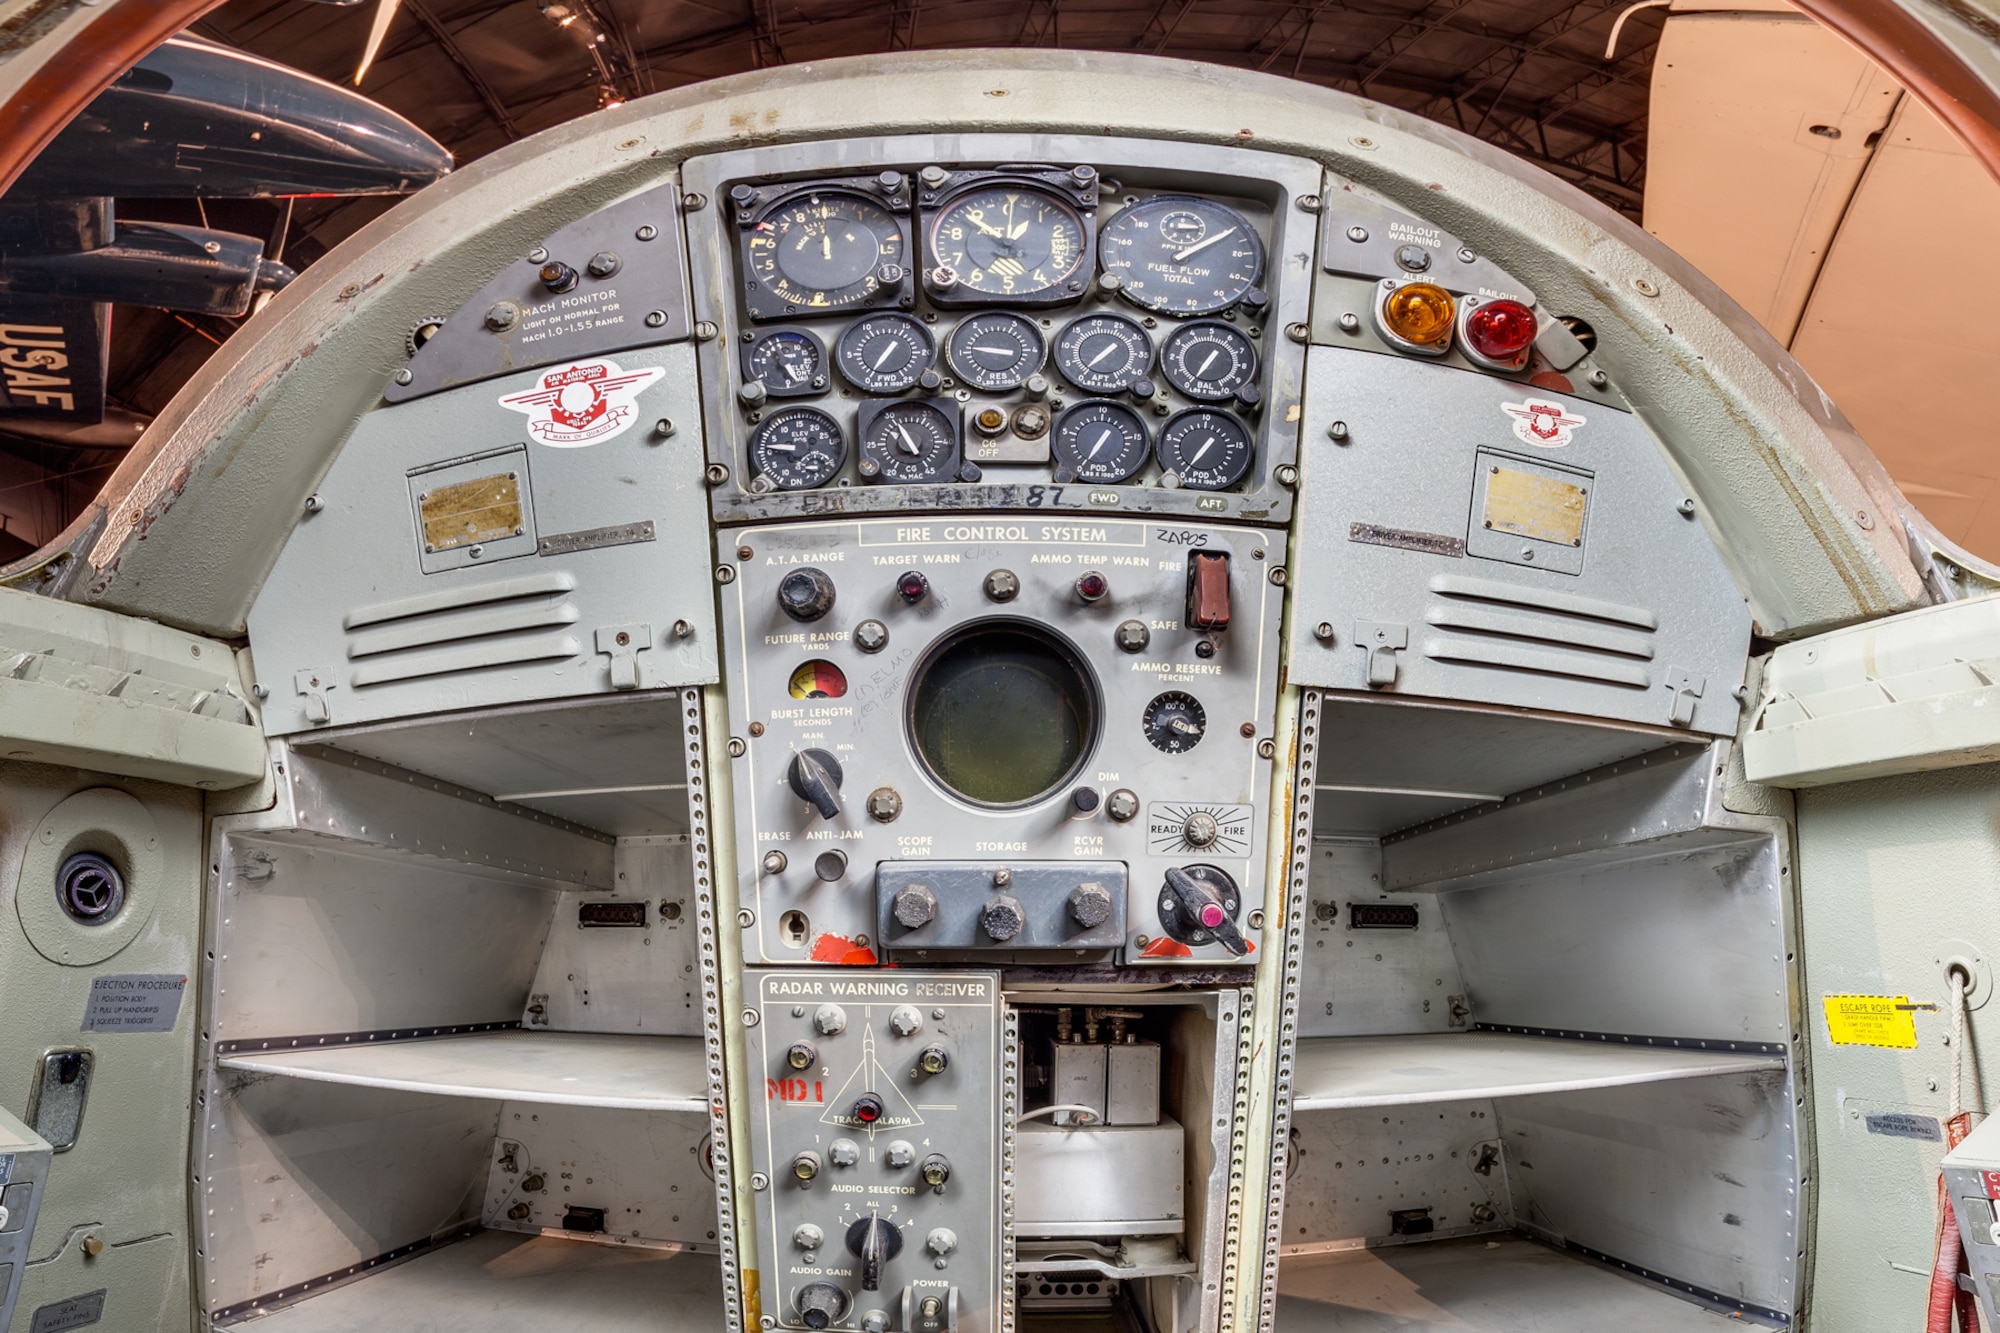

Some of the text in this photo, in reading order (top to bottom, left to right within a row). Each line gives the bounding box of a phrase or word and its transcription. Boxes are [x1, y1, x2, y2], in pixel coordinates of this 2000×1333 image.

[796, 212, 806, 223] 8
[951, 228, 962, 240] 8
[1390, 223, 1441, 239] BAILOUT
[1388, 231, 1442, 248] WARNING
[952, 252, 963, 265] 7
[1147, 263, 1210, 277] FUEL FLOW
[970, 269, 983, 282] 6
[1163, 274, 1195, 285] TOTAL
[1402, 272, 1436, 284] ALERT
[1003, 276, 1014, 289] 5
[1478, 287, 1519, 301] BAILOUT
[522, 290, 617, 317] MACH MONITOR
[522, 303, 620, 330] LIGHT ON NORMAL FOR
[522, 332, 545, 344] MACH
[595, 315, 624, 327] RANGE
[862, 323, 872, 331] 10
[0, 324, 74, 411] USAF
[547, 374, 563, 382] SAN
[567, 366, 603, 379] ANTONIO
[1091, 374, 1109, 382] AFT
[903, 376, 913, 384] 25
[1197, 382, 1214, 390] BAL
[809, 424, 820, 432] 20
[819, 432, 829, 440] 25
[978, 449, 999, 457] OFF
[905, 465, 917, 473] CG
[925, 467, 936, 475] 45
[1090, 464, 1107, 472] POD
[1114, 468, 1125, 476] 20
[1192, 471, 1210, 479] POD
[790, 478, 802, 486] DN
[1090, 494, 1119, 503] FWD
[1200, 499, 1222, 508] AFT
[897, 526, 1107, 542] FIRE CONTROL SYSTEM
[557, 538, 580, 547] DRIVER
[803, 552, 845, 564] RANGE
[873, 554, 960, 566] TARGET WARN
[1030, 554, 1149, 567] AMMO TEMP WARN
[1159, 562, 1182, 572] FIRE
[1151, 620, 1178, 630] SAFE
[764, 631, 850, 645] FUTURE RANGE
[801, 642, 830, 651] YARDS
[1132, 662, 1222, 675] AMMO RESERVE
[1158, 673, 1195, 683] PERCENT
[770, 707, 853, 720] BURST LENGTH
[793, 718, 832, 727] SECONDS
[802, 732, 826, 740] MAN.
[836, 743, 856, 751] MIN.
[1170, 740, 1180, 748] 50
[1098, 772, 1120, 781] DIM
[1151, 825, 1184, 834] READY
[1224, 827, 1245, 835] FIRE
[758, 831, 791, 841] ERASE
[806, 830, 864, 840] ANTI-JAM
[898, 837, 933, 846] SCOPE
[1074, 836, 1103, 846] RCVR
[901, 847, 930, 856] GAIN
[976, 842, 1028, 852] STORAGE
[1073, 846, 1103, 855] GAIN
[94, 980, 182, 990] EJECTION PROCEDURE
[770, 981, 985, 996] RADAR WARNING RECEIVER
[1840, 1003, 1892, 1013] ESCAPE ROPE
[822, 1067, 830, 1076] 2
[833, 1115, 911, 1126] TRAC ALARM
[1883, 1115, 1905, 1123] ACCESS
[1873, 1121, 1893, 1130] ESCAPE
[1894, 1123, 1908, 1131] ROPE
[831, 1184, 916, 1195] AUDIO SELECTOR
[790, 1267, 852, 1277] AUDIO GAIN
[913, 1279, 949, 1288] POWER
[60, 1304, 78, 1314] SEAT
[43, 1311, 90, 1328] SAFETY PINS
